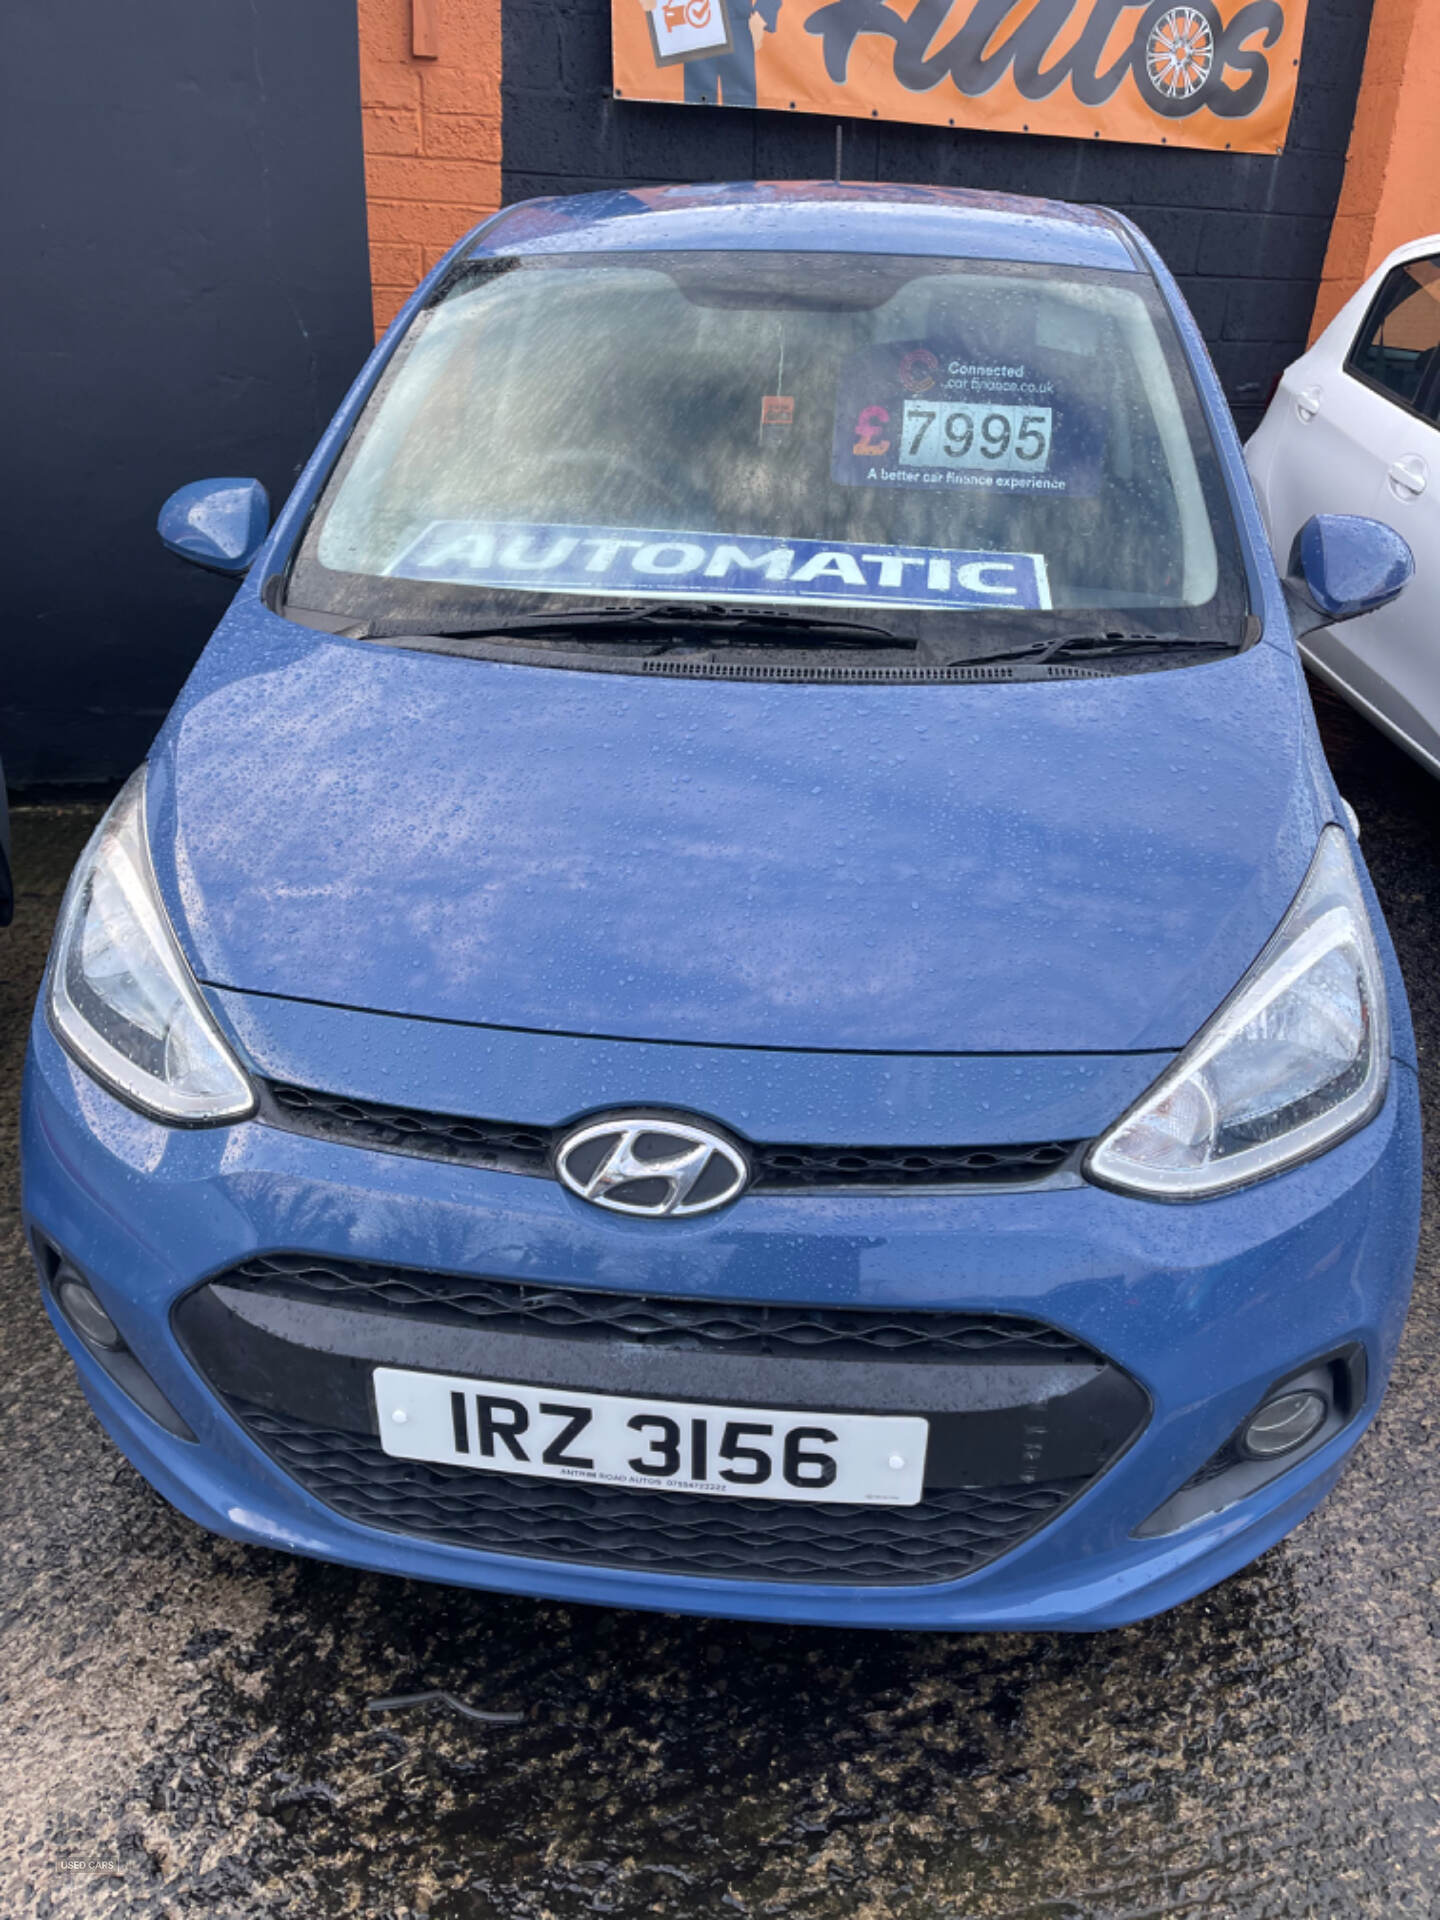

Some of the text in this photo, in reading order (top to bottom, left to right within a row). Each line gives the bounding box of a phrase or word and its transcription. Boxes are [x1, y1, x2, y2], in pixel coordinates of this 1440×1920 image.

[947, 361, 1024, 378] Connected
[906, 410, 1047, 462] 7995
[866, 468, 1066, 490] A better car finance experience
[416, 533, 1017, 595] AUTOMATIC
[451, 1390, 839, 1489] IRZ 3156
[629, 1475, 662, 1486] AUTOS
